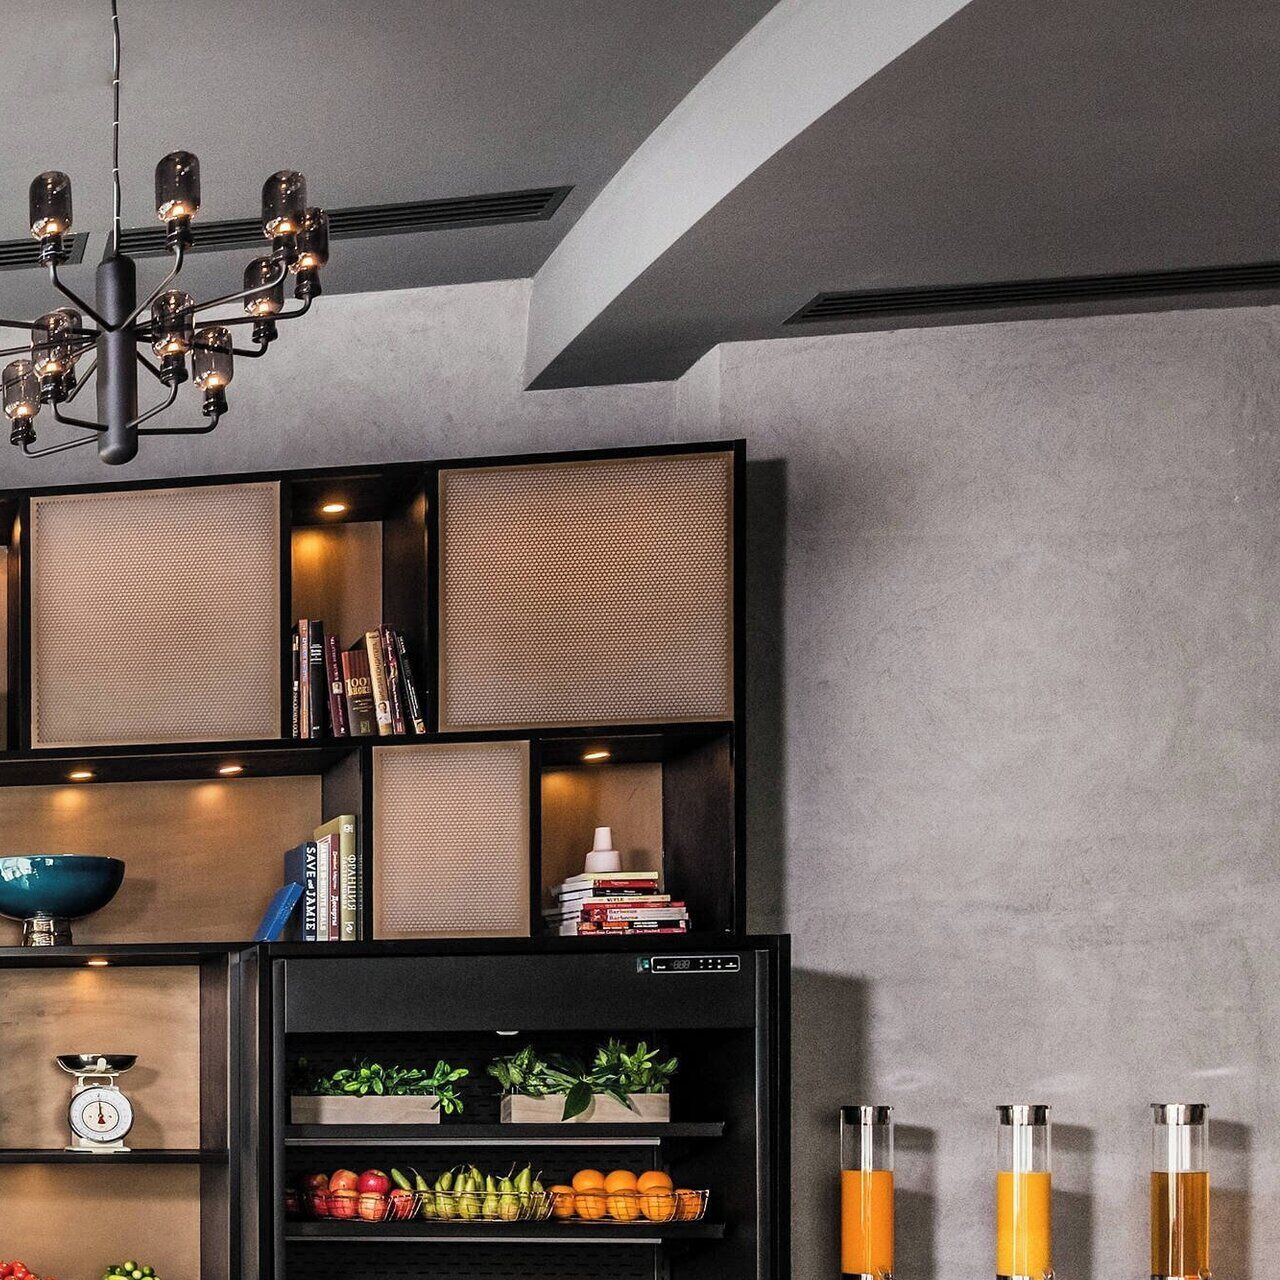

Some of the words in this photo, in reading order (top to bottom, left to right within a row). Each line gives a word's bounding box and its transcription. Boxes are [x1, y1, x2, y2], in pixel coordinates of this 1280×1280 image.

[306, 847, 316, 878] SAVE
[347, 854, 357, 911] ФРАНЦИЯ
[306, 889, 316, 931] JAMIE
[330, 895, 339, 926] Десерты
